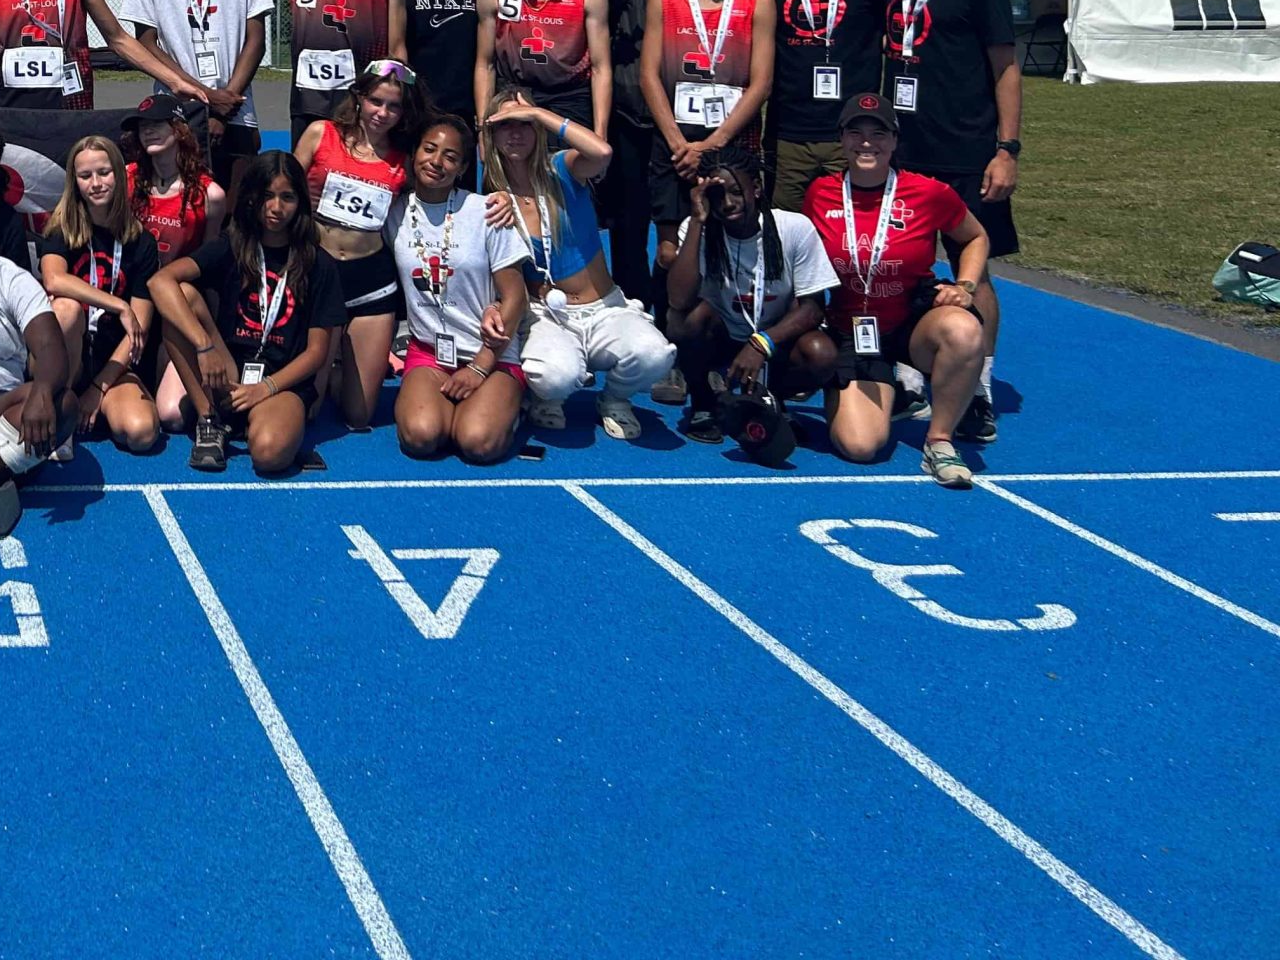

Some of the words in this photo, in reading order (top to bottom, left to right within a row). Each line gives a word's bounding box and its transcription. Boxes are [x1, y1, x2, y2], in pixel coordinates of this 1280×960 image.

[29, 0, 58, 9] ST-LOU
[529, 14, 564, 25] ST-LOUIS
[14, 60, 53, 78] LSL
[308, 63, 345, 80] LSL
[333, 190, 374, 219] LSL
[842, 233, 889, 252] LAC
[833, 257, 903, 276] SAINT
[850, 277, 905, 298] OUIS
[236, 328, 251, 336] LAC
[348, 524, 500, 639] 4
[798, 518, 1078, 632] 3
